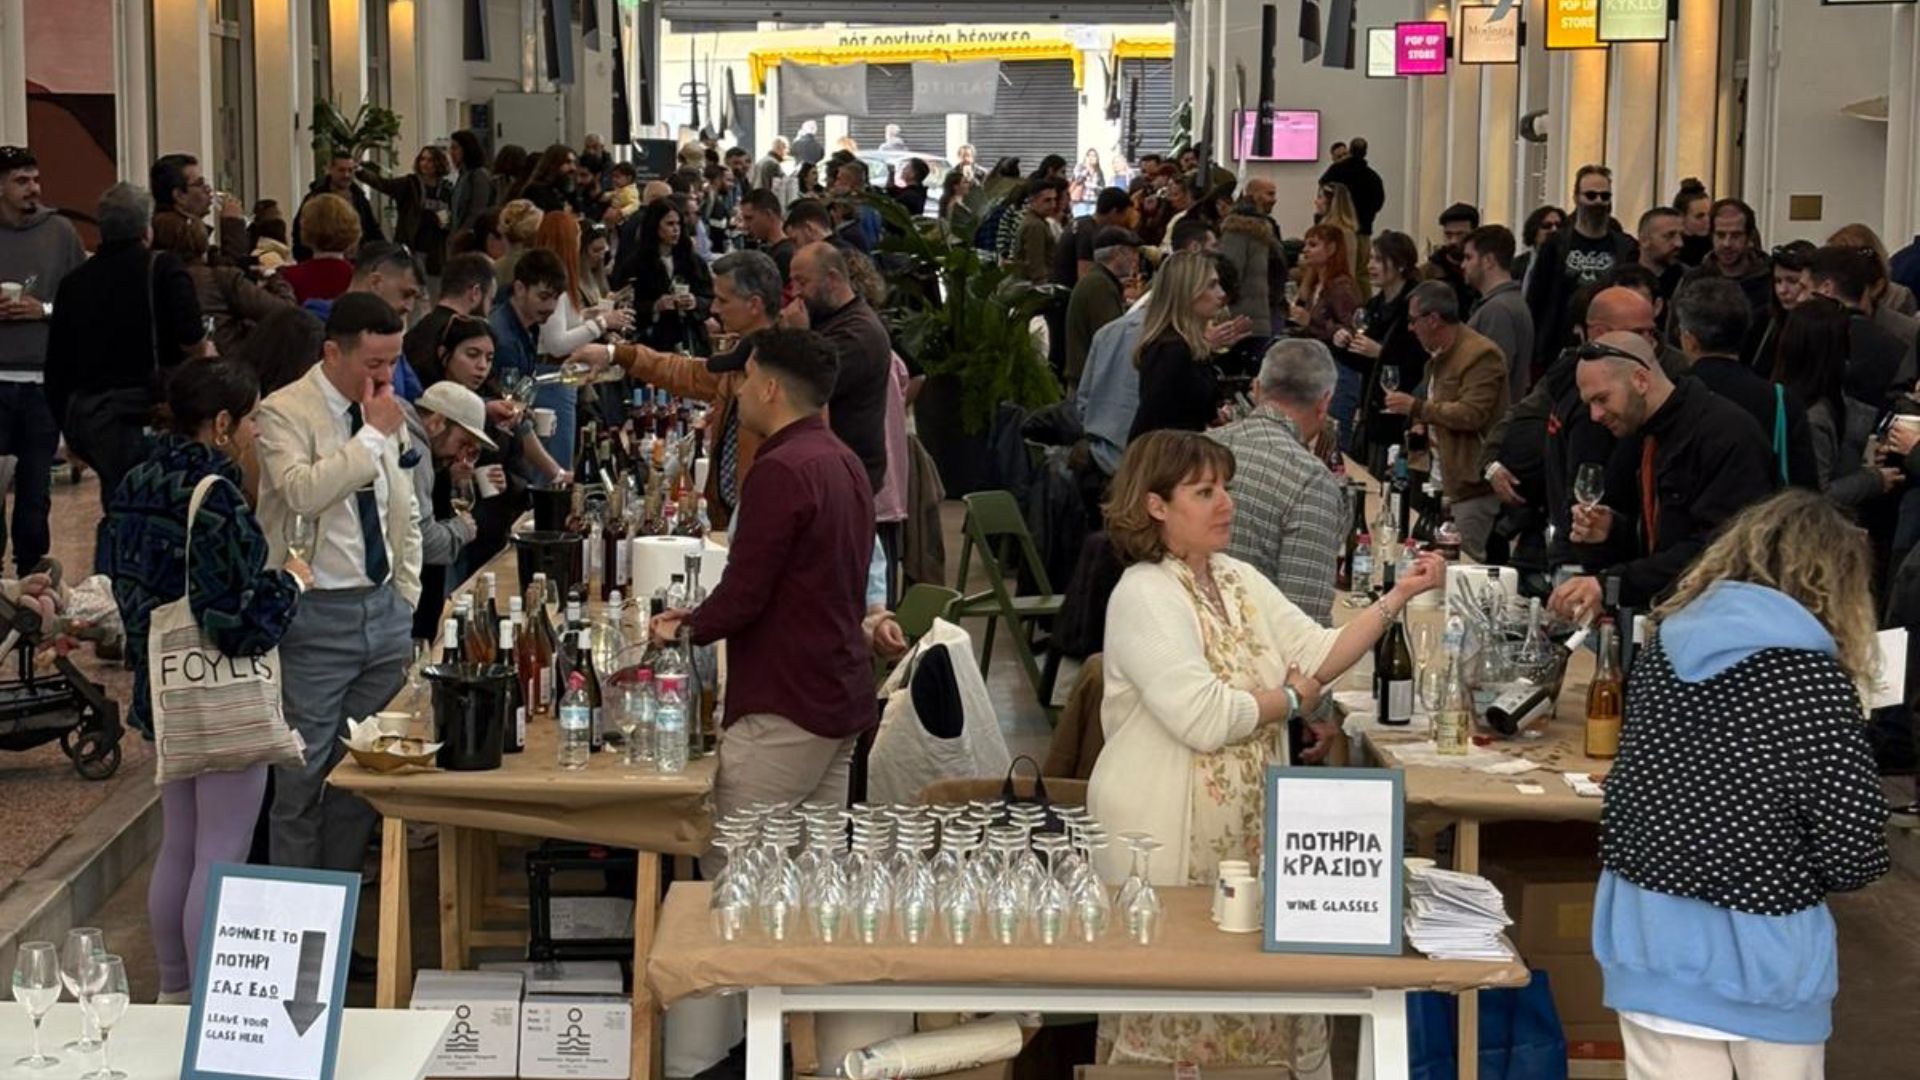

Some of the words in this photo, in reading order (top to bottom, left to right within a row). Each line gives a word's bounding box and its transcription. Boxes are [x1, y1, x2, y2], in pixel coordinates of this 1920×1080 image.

[1404, 35, 1423, 46] POP
[1425, 35, 1440, 46] UP
[1408, 49, 1437, 60] STORE
[1285, 831, 1382, 853] ΠΟΤΗΡΙΑ
[1283, 854, 1383, 878] ΚΡΑΣΙΟΥ
[1286, 899, 1317, 911] WINE
[1322, 899, 1379, 913] GLASSES
[282, 932, 299, 945] ΤΟ
[215, 952, 270, 970] ΠΟΤΗΡΙ
[211, 979, 244, 996] ΣΑΣ
[249, 981, 279, 1000] ΕΔΩ
[207, 1012, 239, 1025] LEAVE
[243, 1015, 269, 1028] YOUR
[205, 1029, 236, 1042] GLASS
[239, 1031, 265, 1044] HERE
